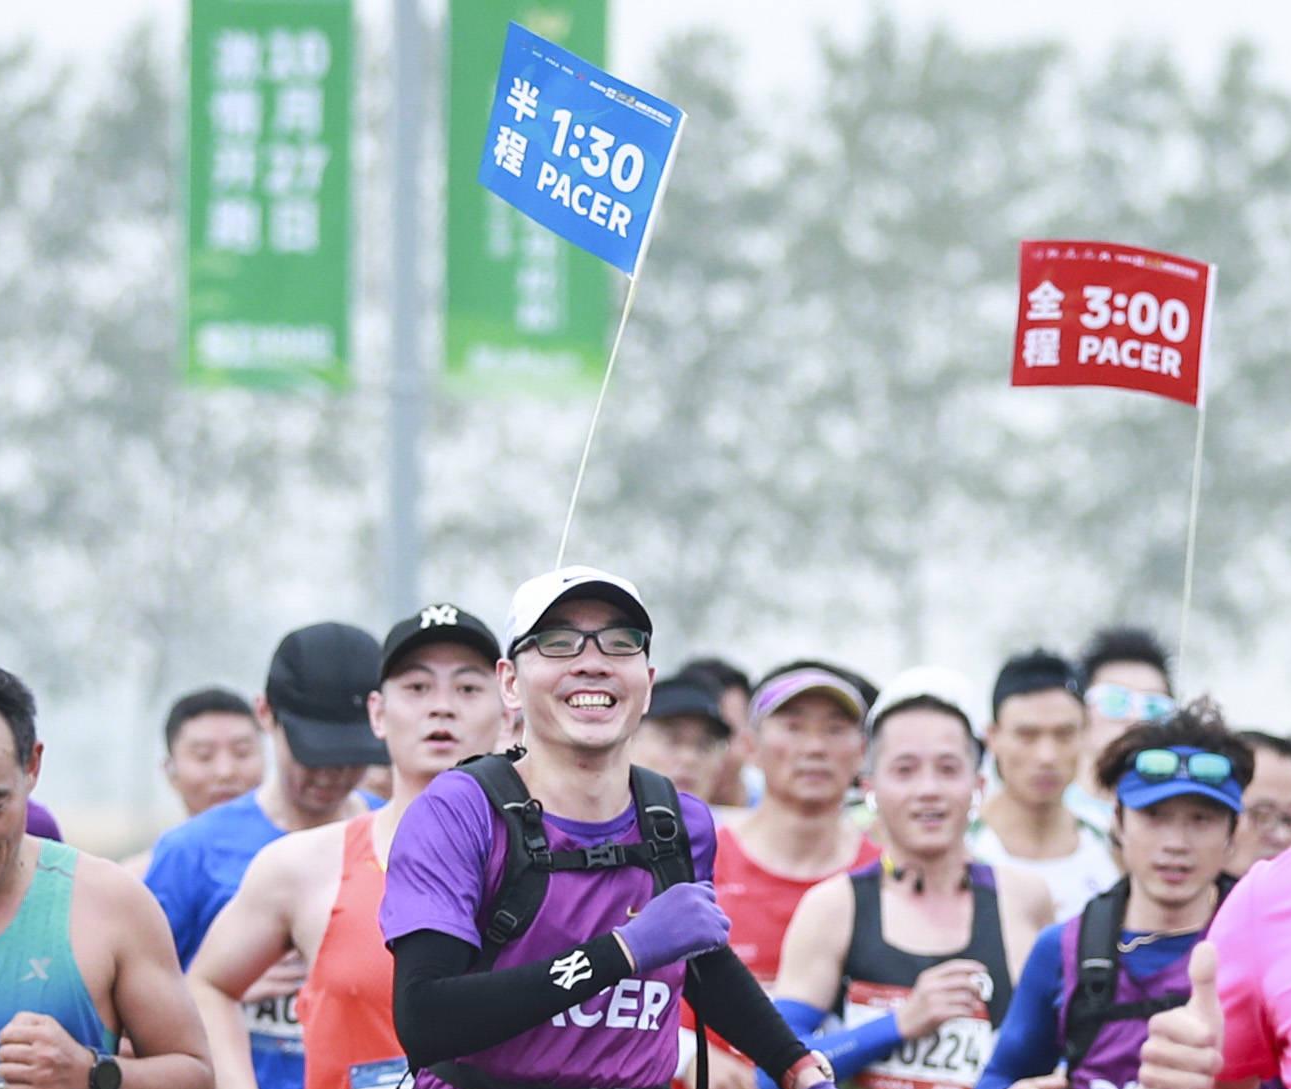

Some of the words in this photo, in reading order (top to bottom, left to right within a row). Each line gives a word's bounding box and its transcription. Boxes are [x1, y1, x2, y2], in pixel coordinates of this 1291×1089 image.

[552, 108, 645, 194] 1:30
[536, 160, 633, 239] PACER
[1079, 284, 1191, 343] 3:00
[1077, 335, 1183, 379] PACER
